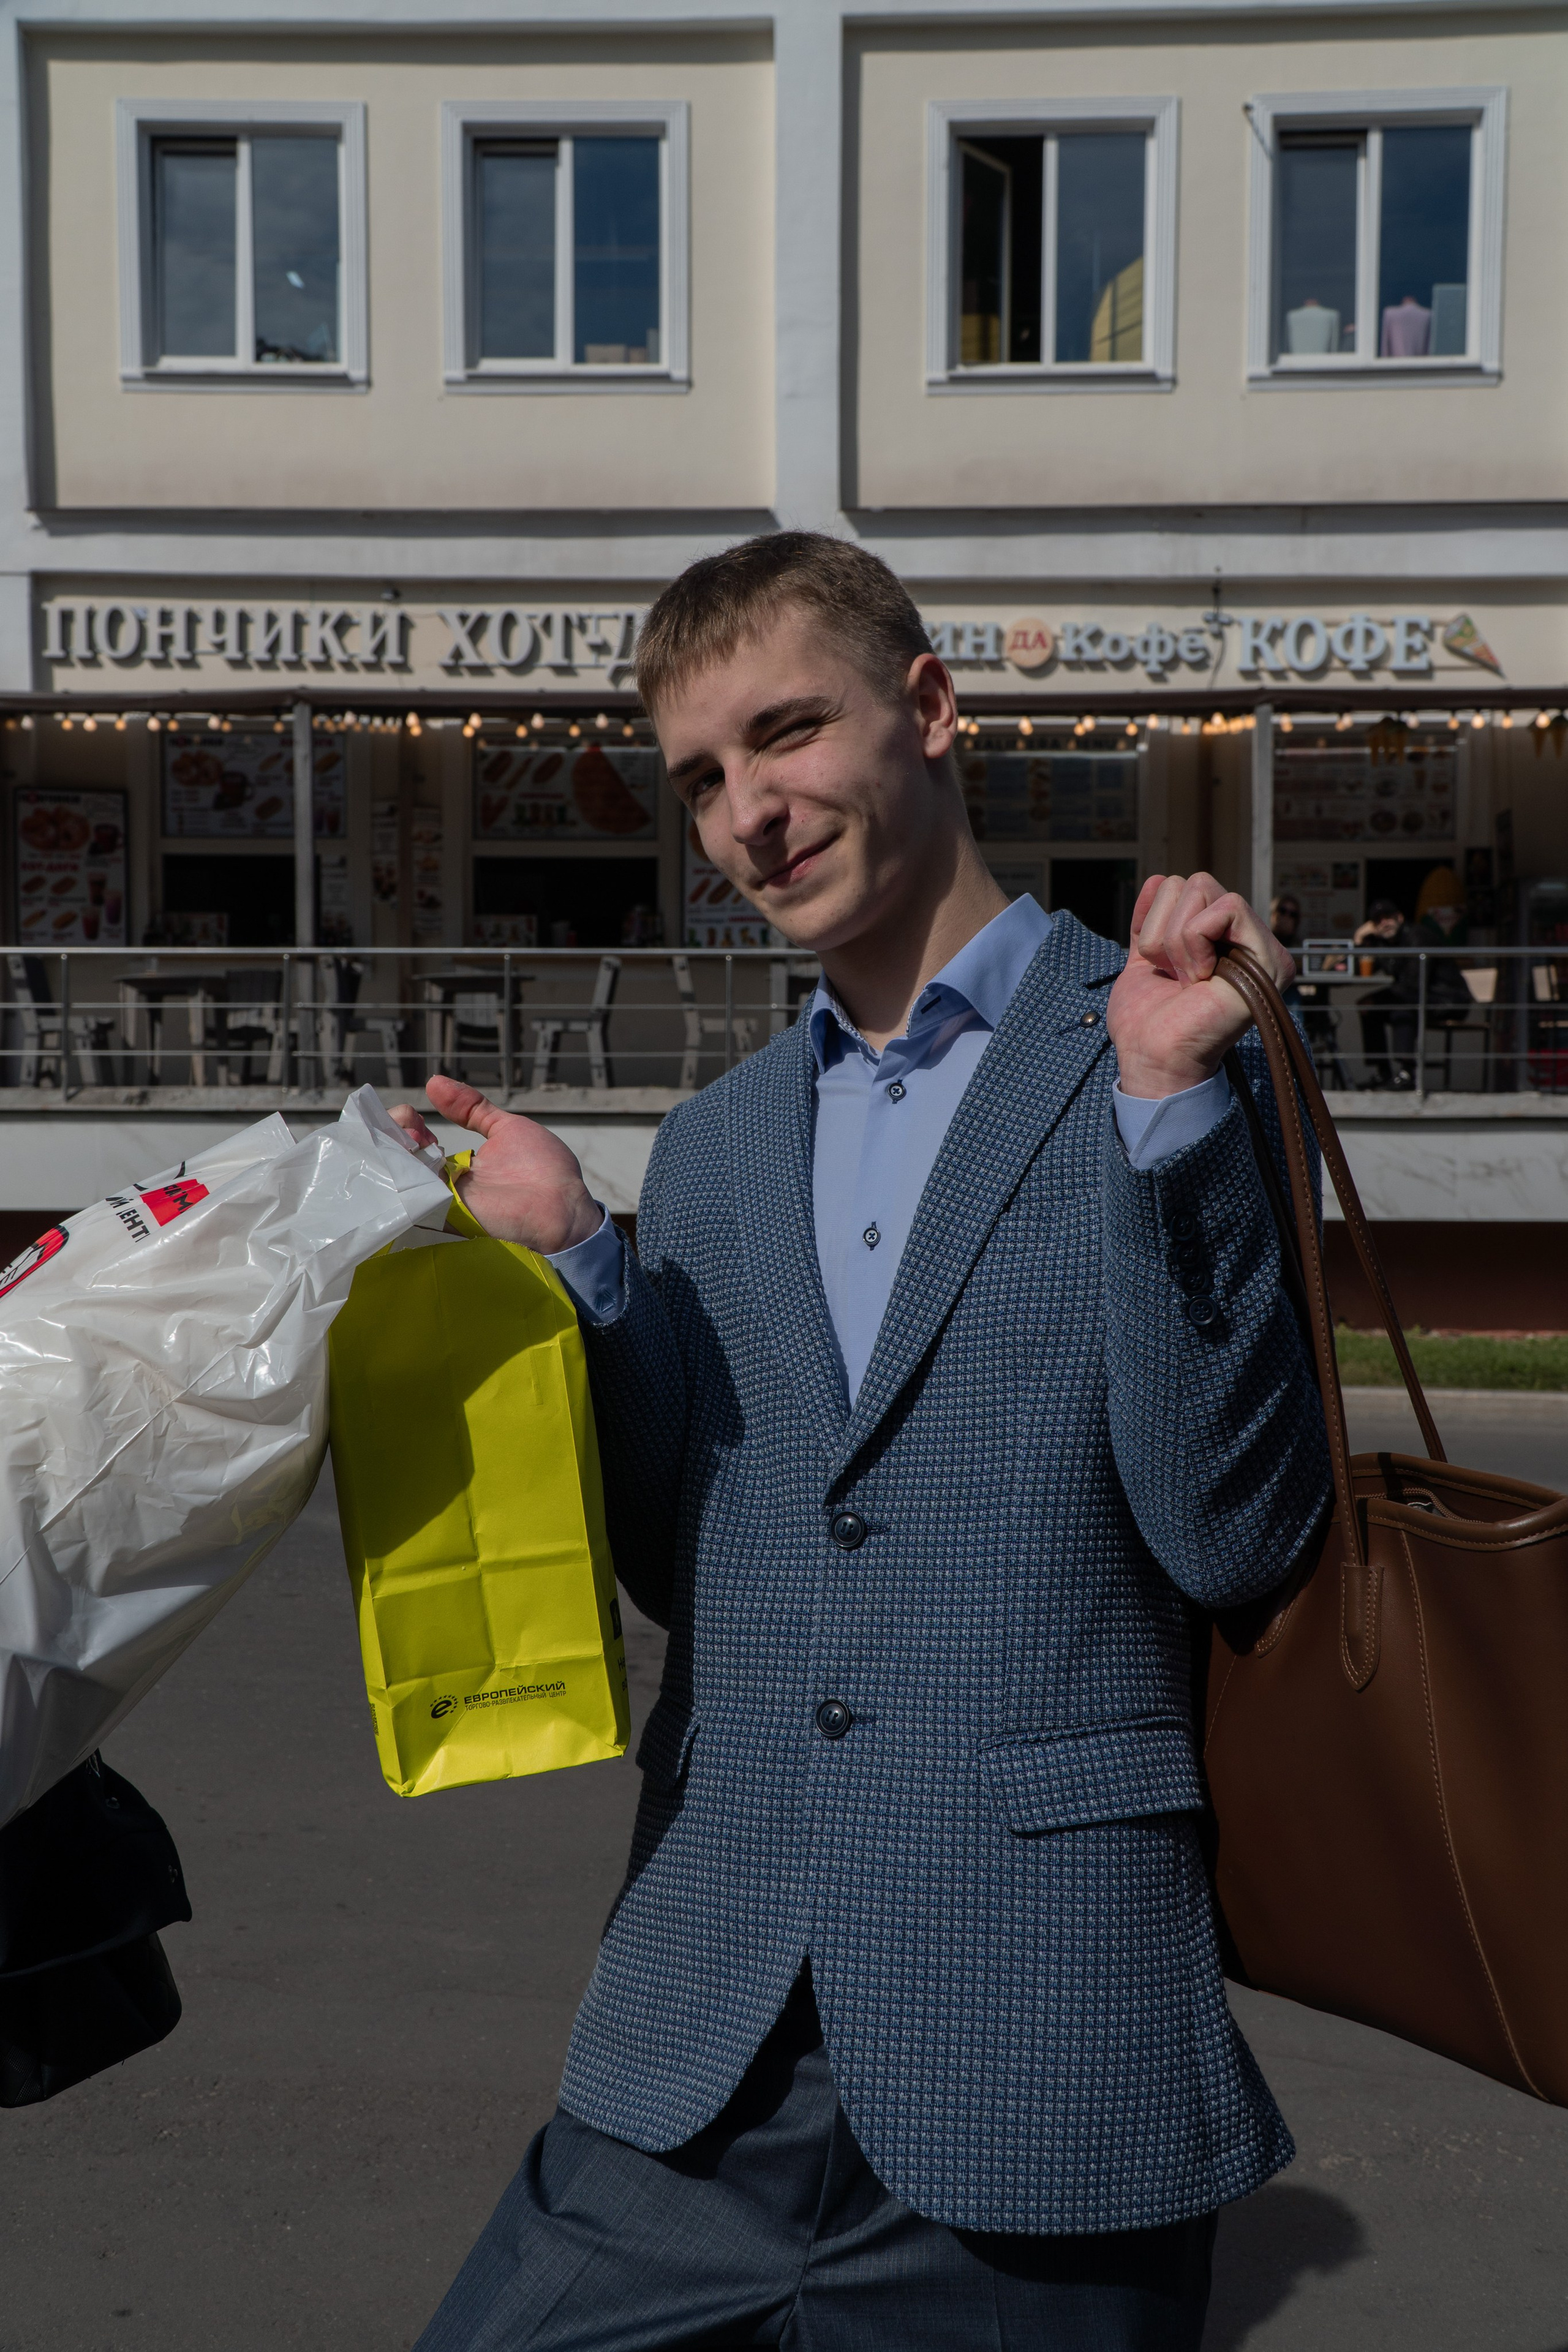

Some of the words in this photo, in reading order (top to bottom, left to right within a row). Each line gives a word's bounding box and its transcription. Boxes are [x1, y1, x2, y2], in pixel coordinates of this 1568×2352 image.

[41, 601, 405, 663] ПОНЧИКИ
[438, 610, 641, 679] ХОТ-Д
[922, 622, 1001, 660] ИН
[1009, 630, 1048, 651] ДА
[1060, 622, 1207, 673] Кофе
[1237, 613, 1431, 672] КОФЕ
[464, 1681, 565, 1705] ЕВРОПЕЙСКИЙ
[465, 1692, 547, 1711] ТОРГОВО-РАЗВЛЕКАТЕЛЬНЫЙ
